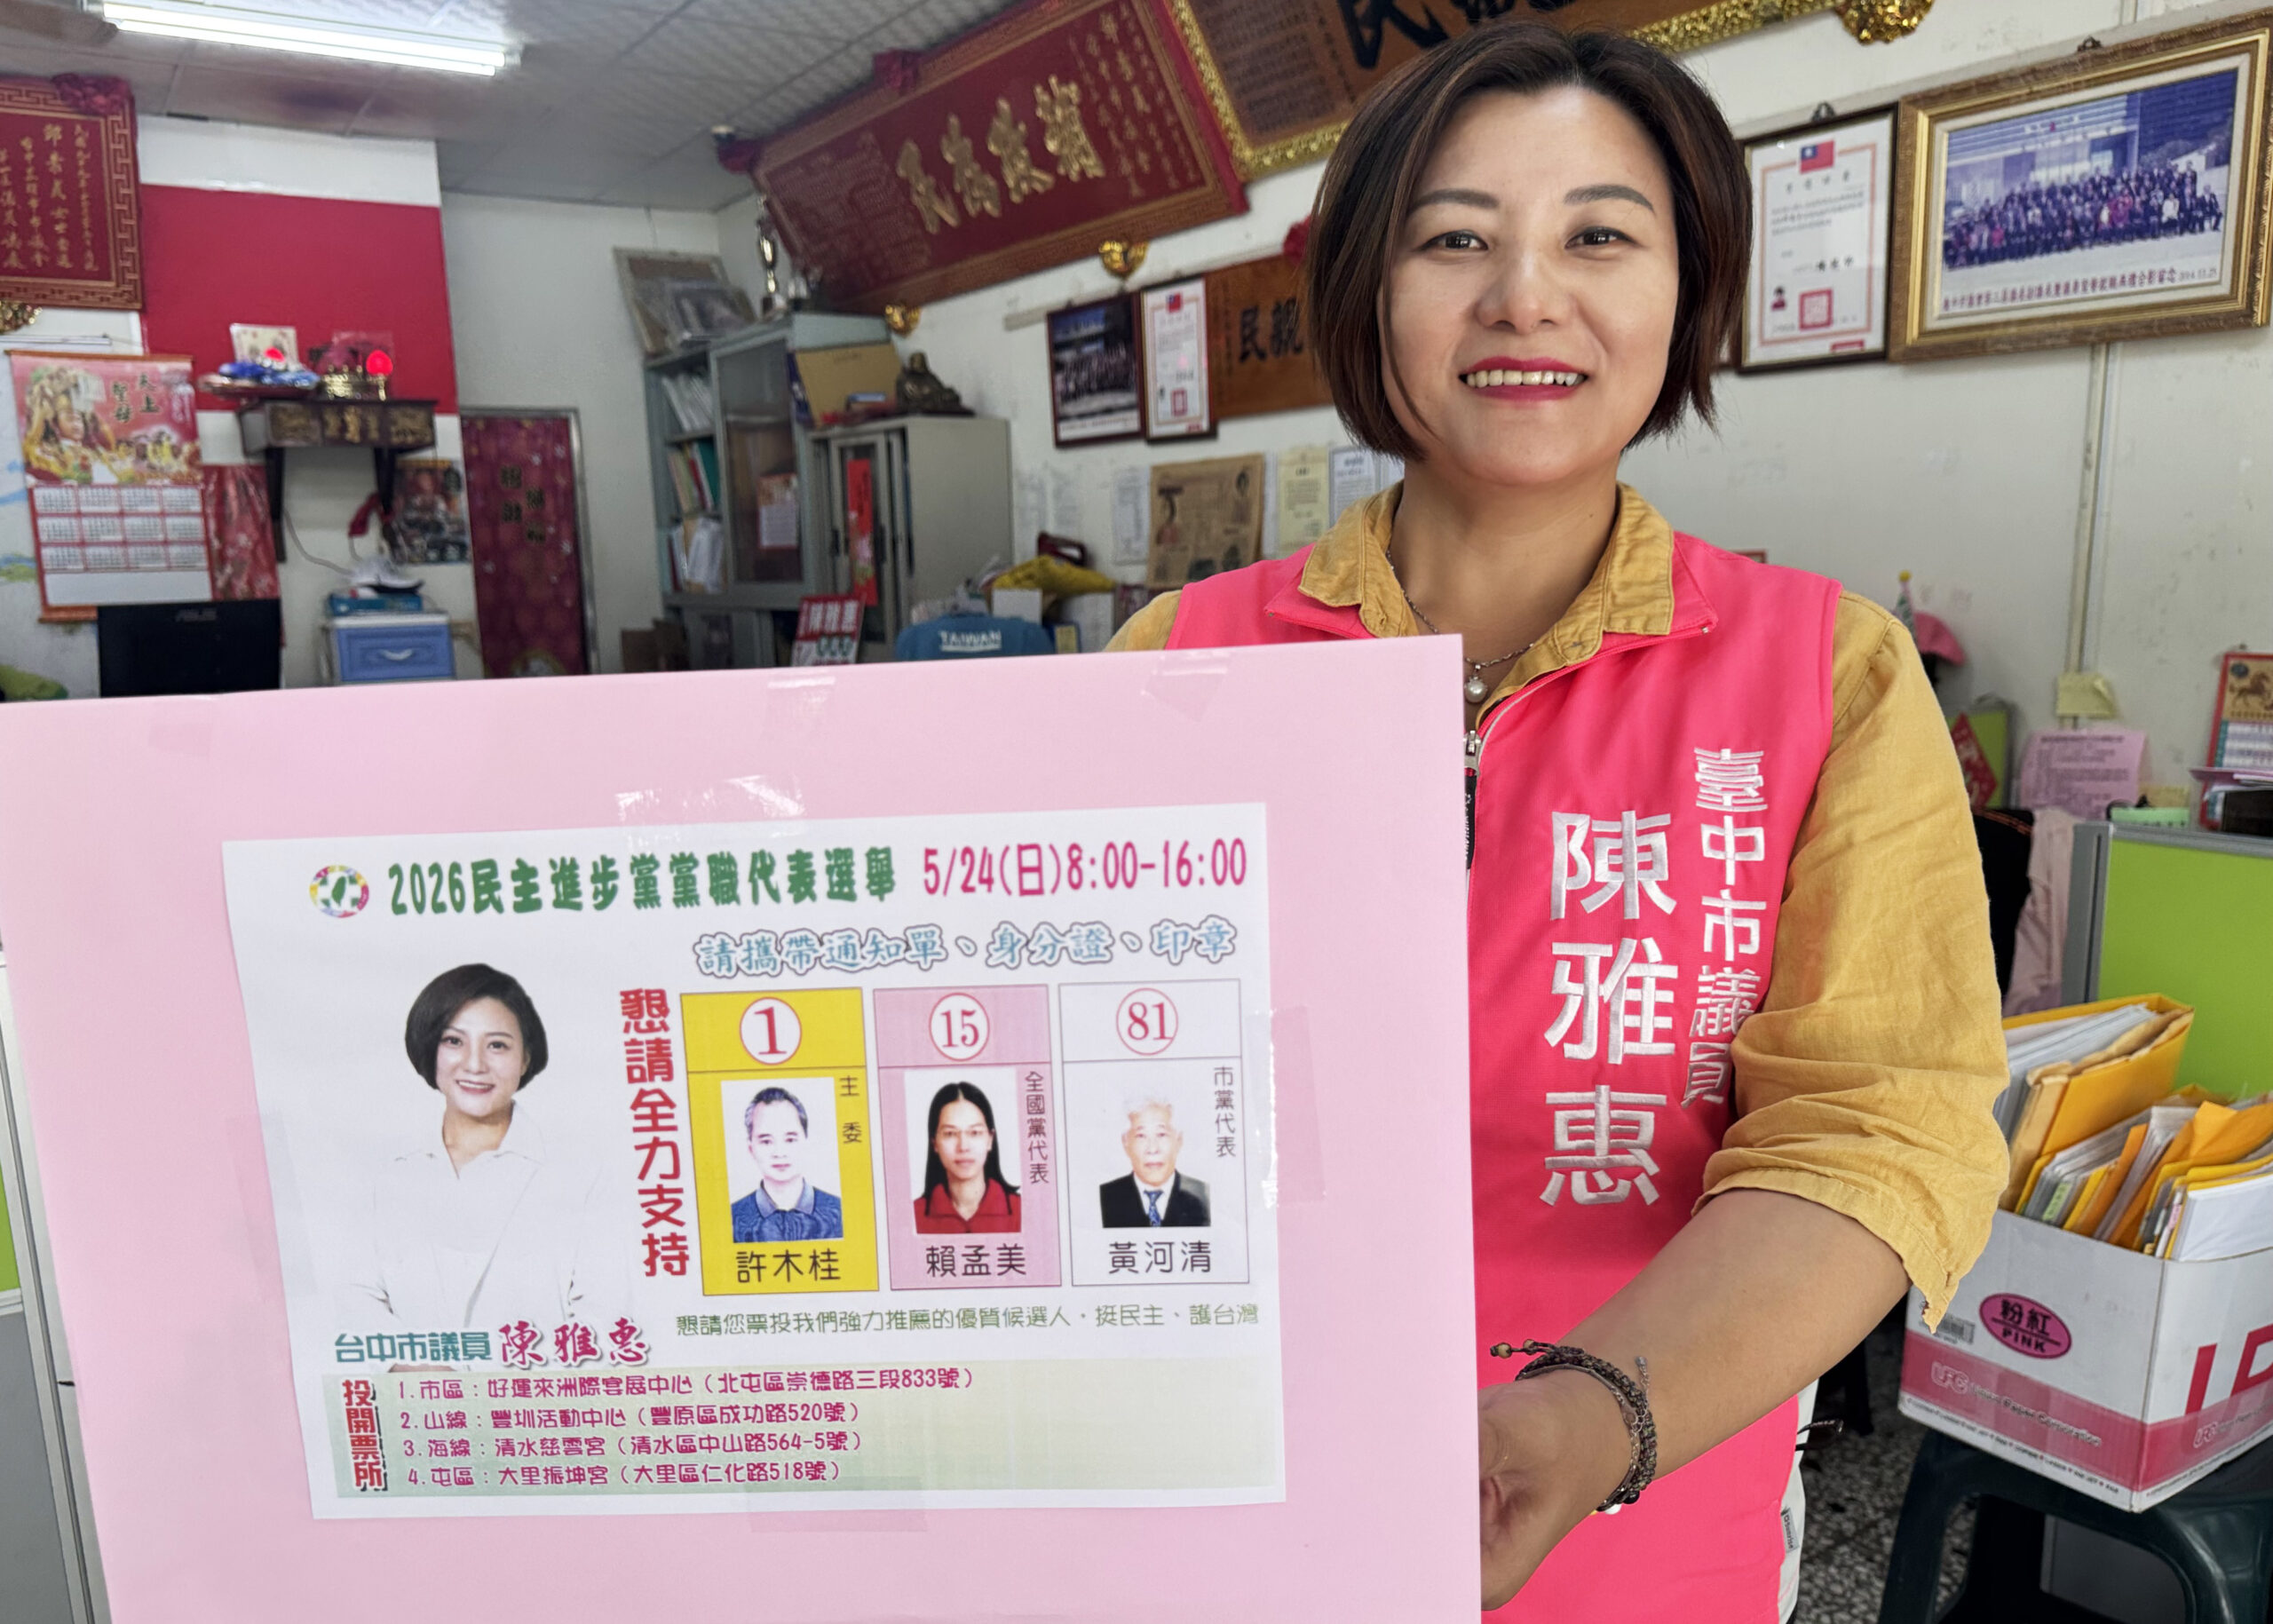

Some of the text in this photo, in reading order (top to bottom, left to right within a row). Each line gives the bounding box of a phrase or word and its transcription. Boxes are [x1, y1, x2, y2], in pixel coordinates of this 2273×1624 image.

[939, 630, 1002, 646] TAIWAN
[388, 846, 897, 915] 2026民主進步黨黨職代表選舉
[1681, 748, 1768, 1110] 臺中市議員
[941, 1009, 980, 1049] 15
[1127, 1001, 1174, 1042] 81
[1540, 811, 1678, 1206] 陳雅惠
[620, 987, 690, 1277] 懇請全力支持
[1025, 1070, 1049, 1185] 全國黨代表
[1213, 1066, 1237, 1158] 市黨代表
[736, 1248, 842, 1284] 許木桂
[925, 1243, 1027, 1279] 賴孟美
[1108, 1240, 1212, 1275] 黃河清
[2000, 1299, 2052, 1337] 粉紅
[2001, 1327, 2047, 1353] PINK
[335, 1317, 651, 1368] 台中市議員 陳雅惠
[343, 1378, 385, 1490] 投開票所
